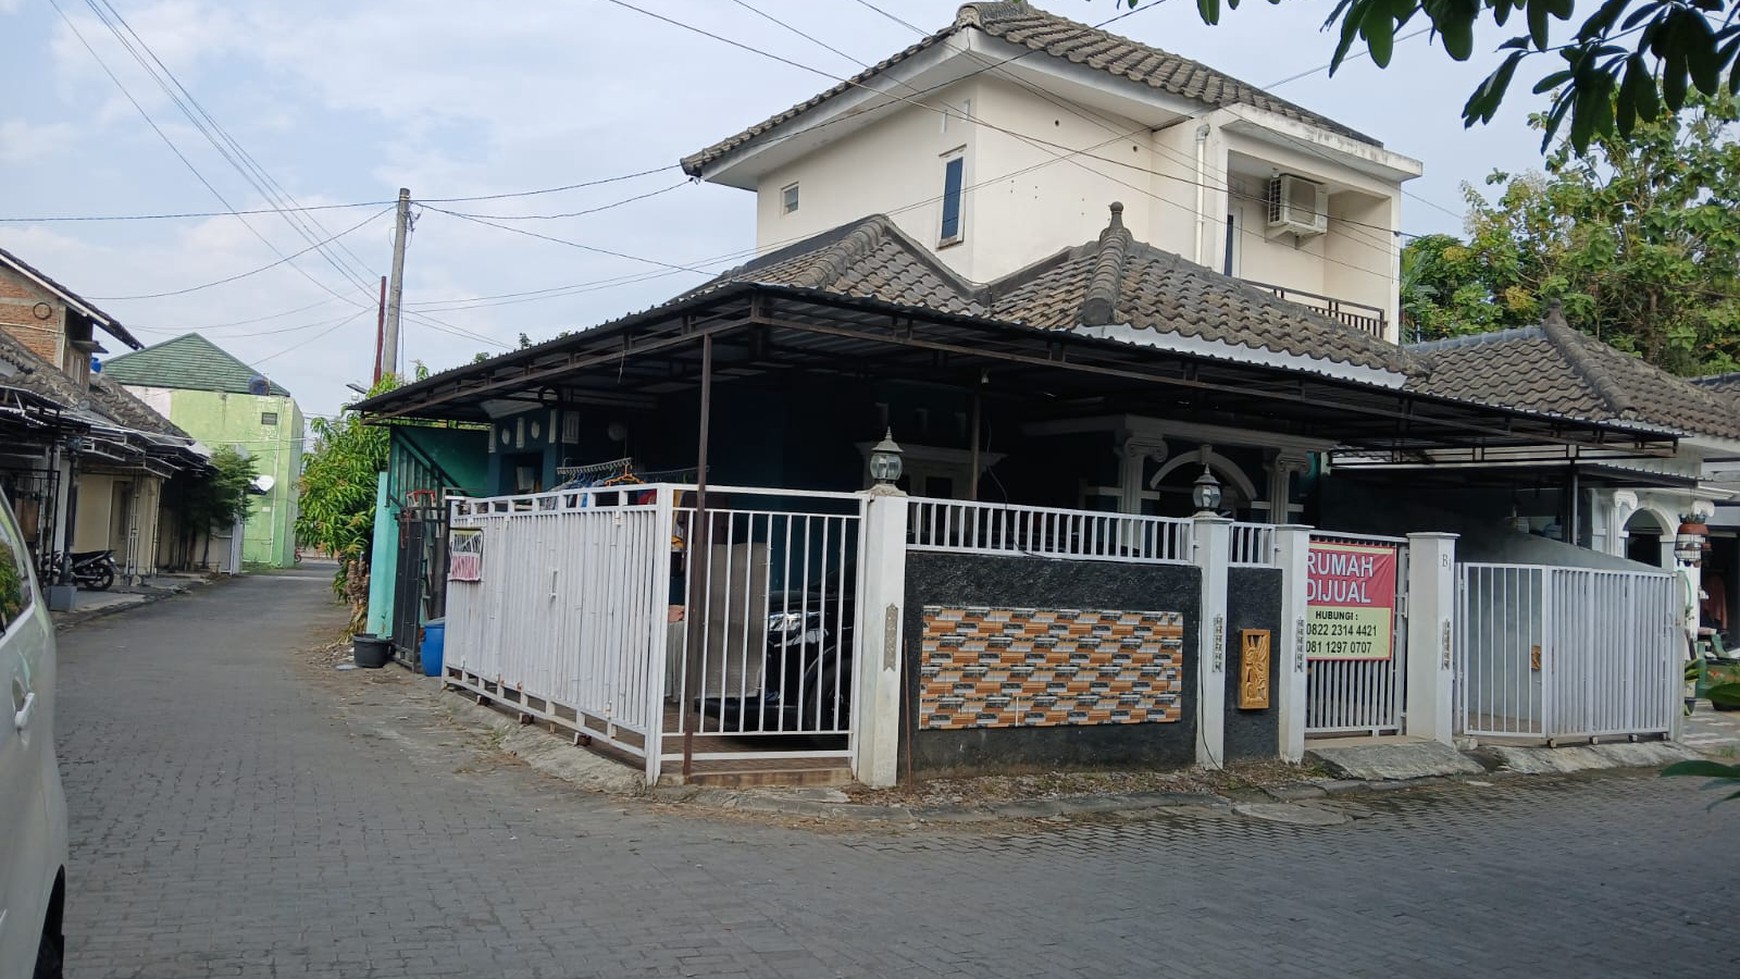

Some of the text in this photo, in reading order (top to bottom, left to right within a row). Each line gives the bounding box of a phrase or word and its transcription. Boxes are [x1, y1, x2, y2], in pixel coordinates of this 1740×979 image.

[1308, 552, 1374, 578] RUMAH
[1307, 578, 1372, 603] DIJUAL
[1315, 610, 1353, 621] HUBUNGI
[1306, 623, 1377, 637] 0822 2314 4421
[1306, 640, 1372, 653] 081 1297 0707
